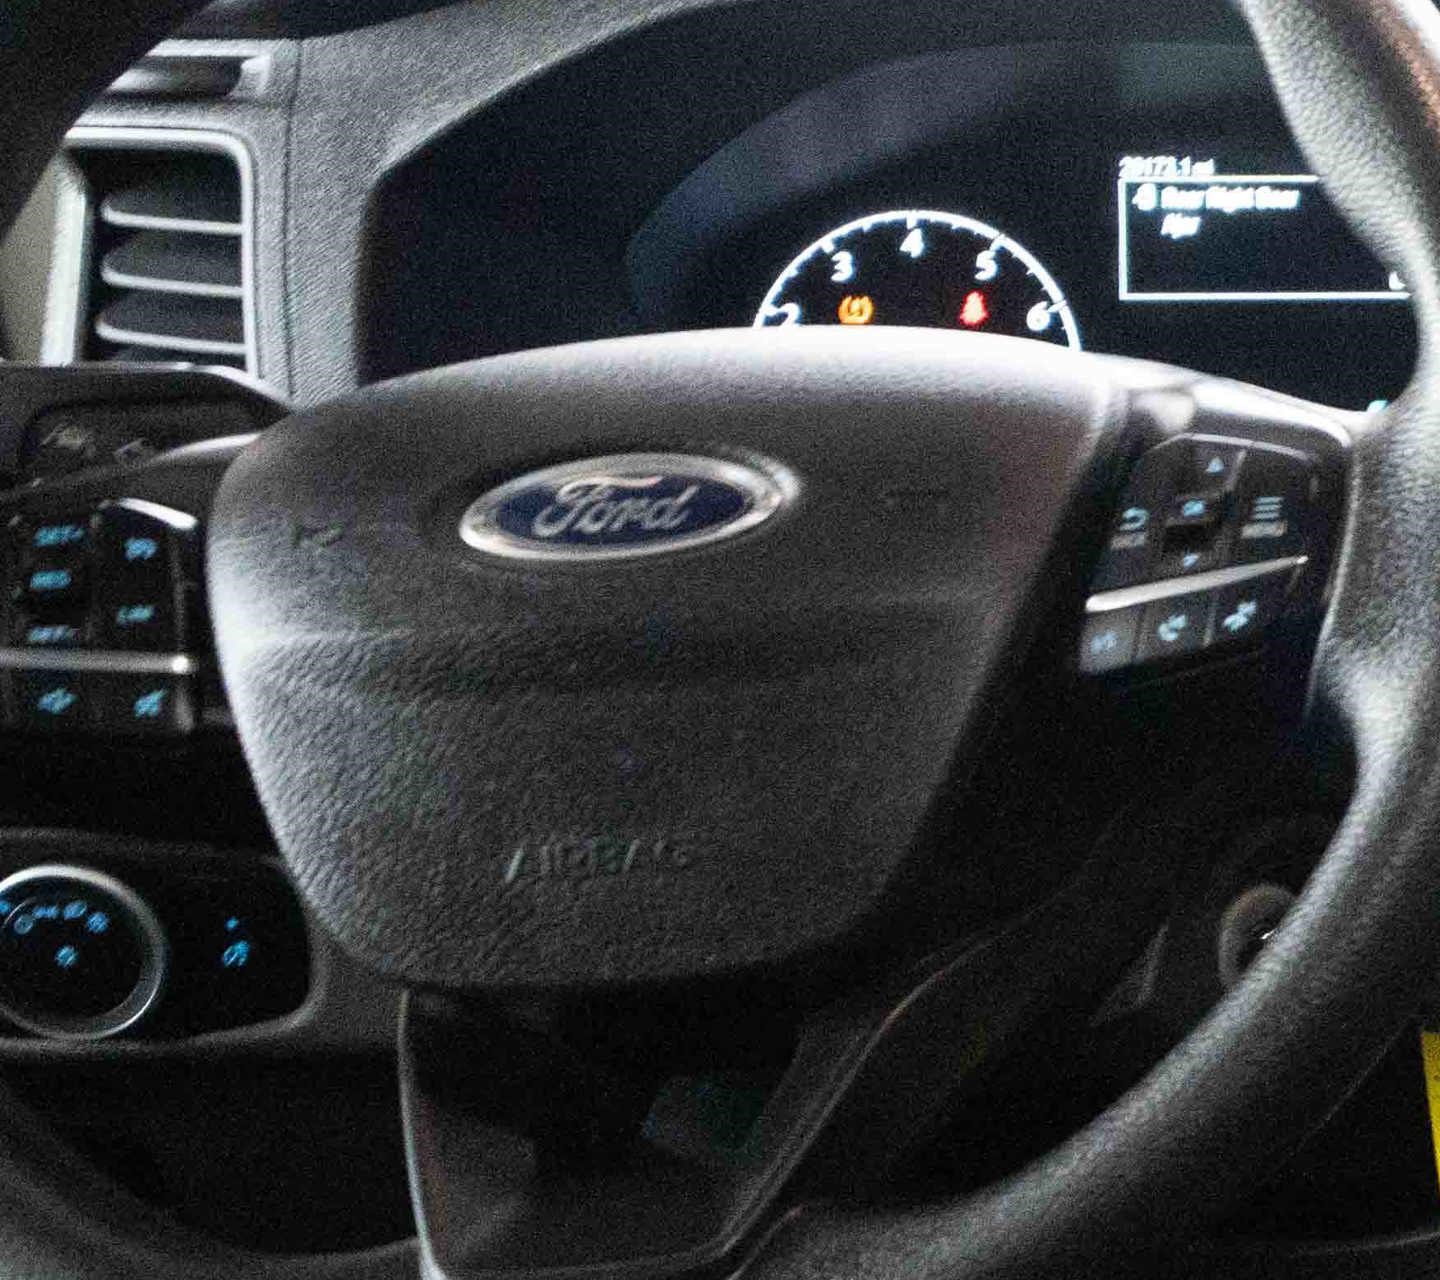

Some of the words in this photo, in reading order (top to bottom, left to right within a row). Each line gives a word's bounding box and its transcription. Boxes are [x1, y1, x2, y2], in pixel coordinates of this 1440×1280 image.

[900, 228, 925, 258] 4
[831, 251, 854, 283] 3
[974, 250, 998, 282] 5
[1026, 301, 1051, 332] 6
[532, 474, 700, 539] Ford
